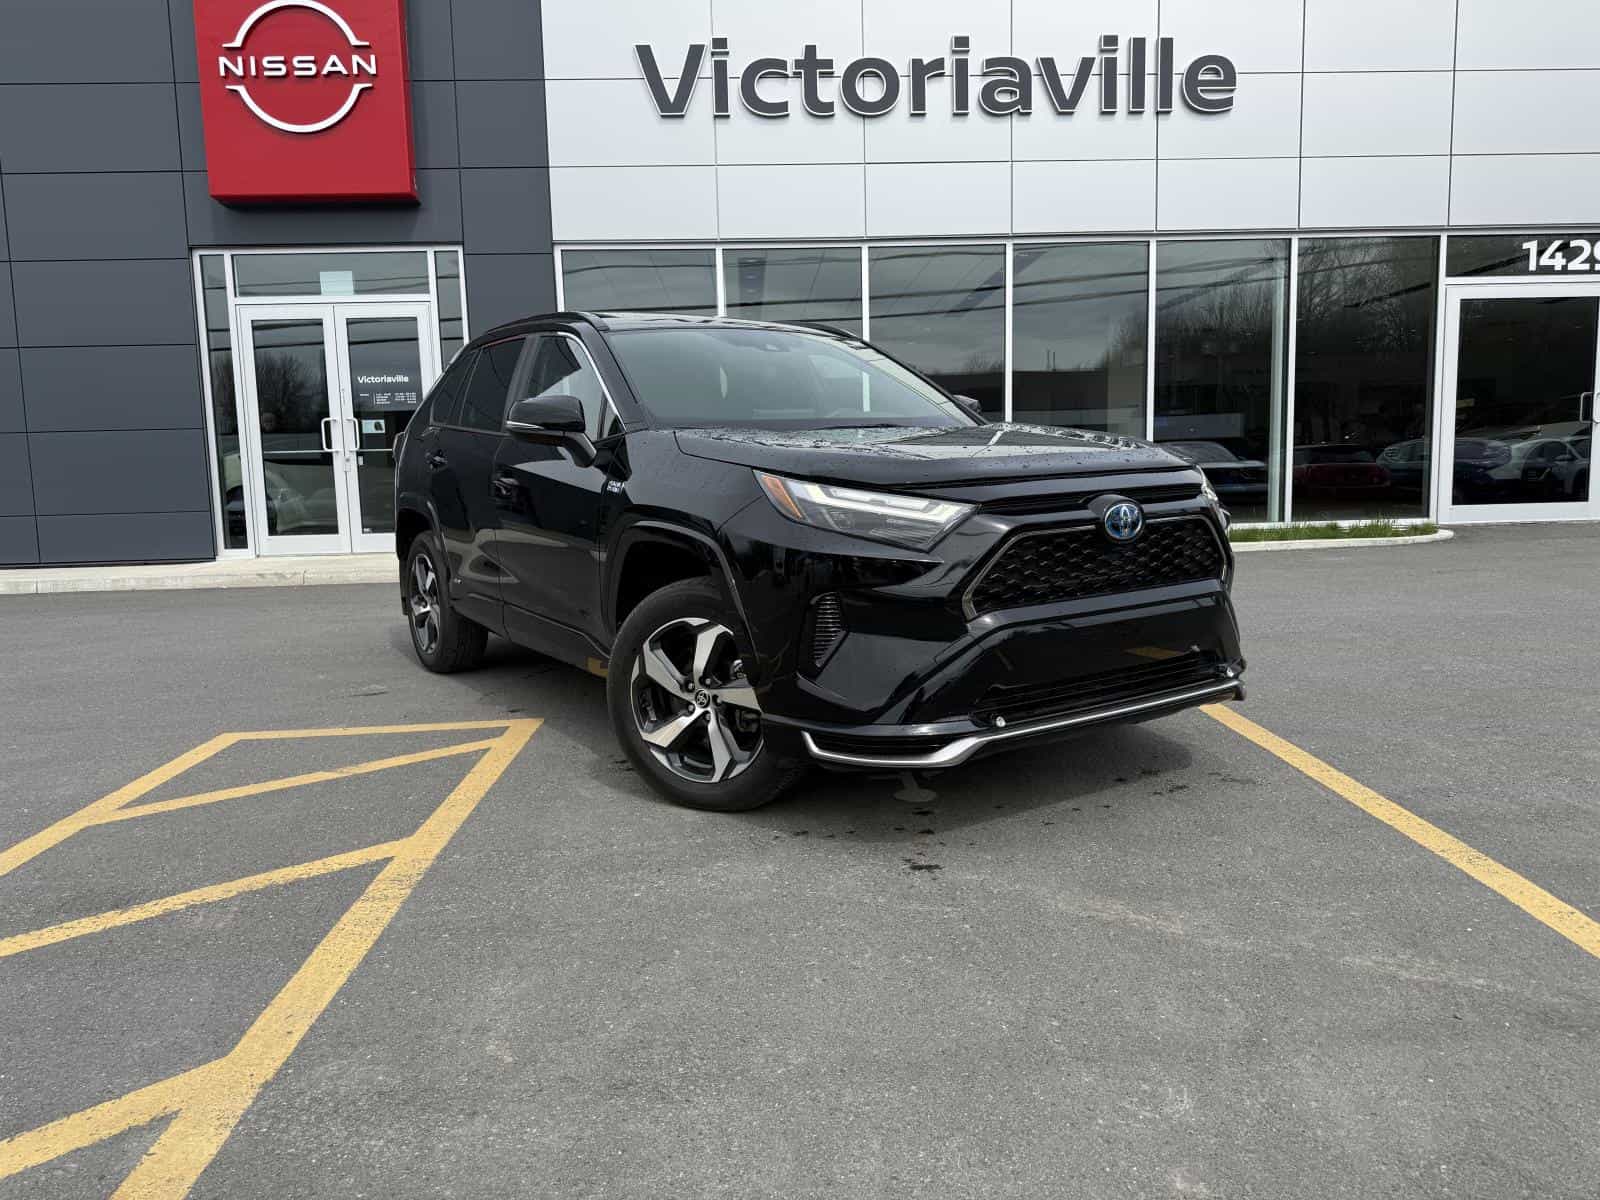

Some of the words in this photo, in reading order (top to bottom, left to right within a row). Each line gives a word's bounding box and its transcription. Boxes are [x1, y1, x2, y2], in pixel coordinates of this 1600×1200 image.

[218, 54, 378, 77] NISSAN
[635, 35, 1237, 118] Victoriaville
[357, 374, 409, 384] Victoriaville
